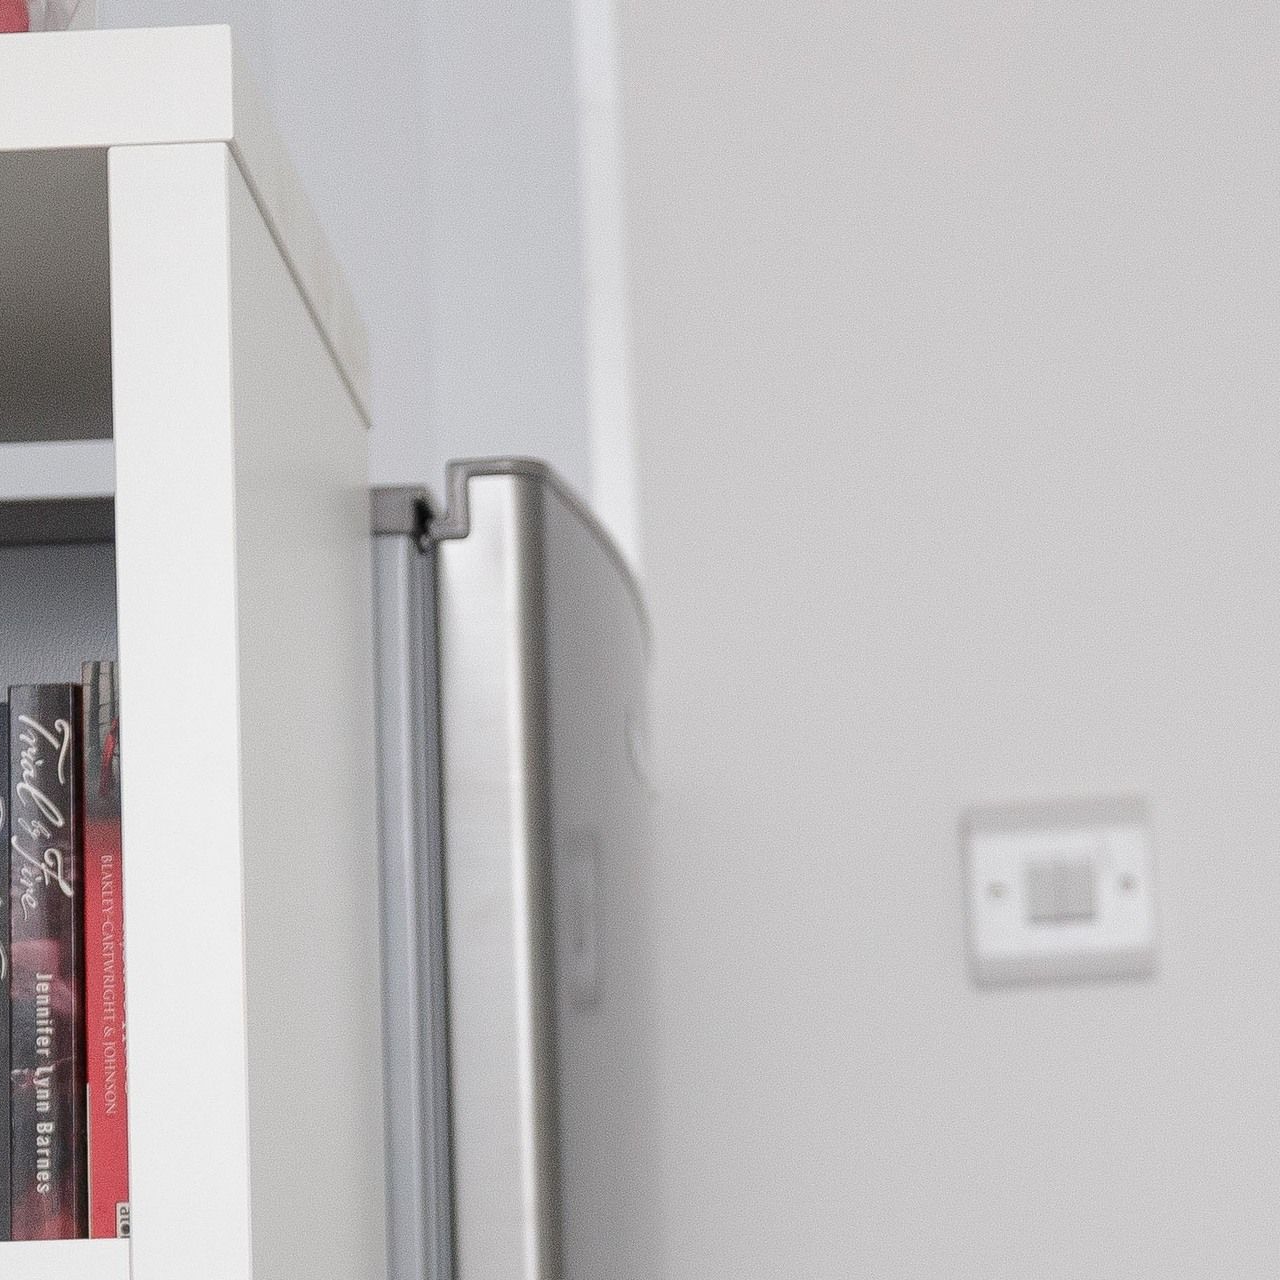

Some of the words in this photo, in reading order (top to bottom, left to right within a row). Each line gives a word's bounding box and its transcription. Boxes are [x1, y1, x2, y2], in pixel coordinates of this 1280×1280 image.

[17, 714, 70, 827] Trial
[18, 817, 51, 841] by
[11, 834, 74, 921] Fire
[101, 855, 116, 1021] BLAKLEY-CARTWRIGHT
[36, 973, 54, 1058] Jennifer
[104, 1027, 116, 1036] &
[33, 1065, 54, 1112] Lynn
[103, 1041, 117, 1114] JOHNSON
[36, 1122, 54, 1194] Barnes
